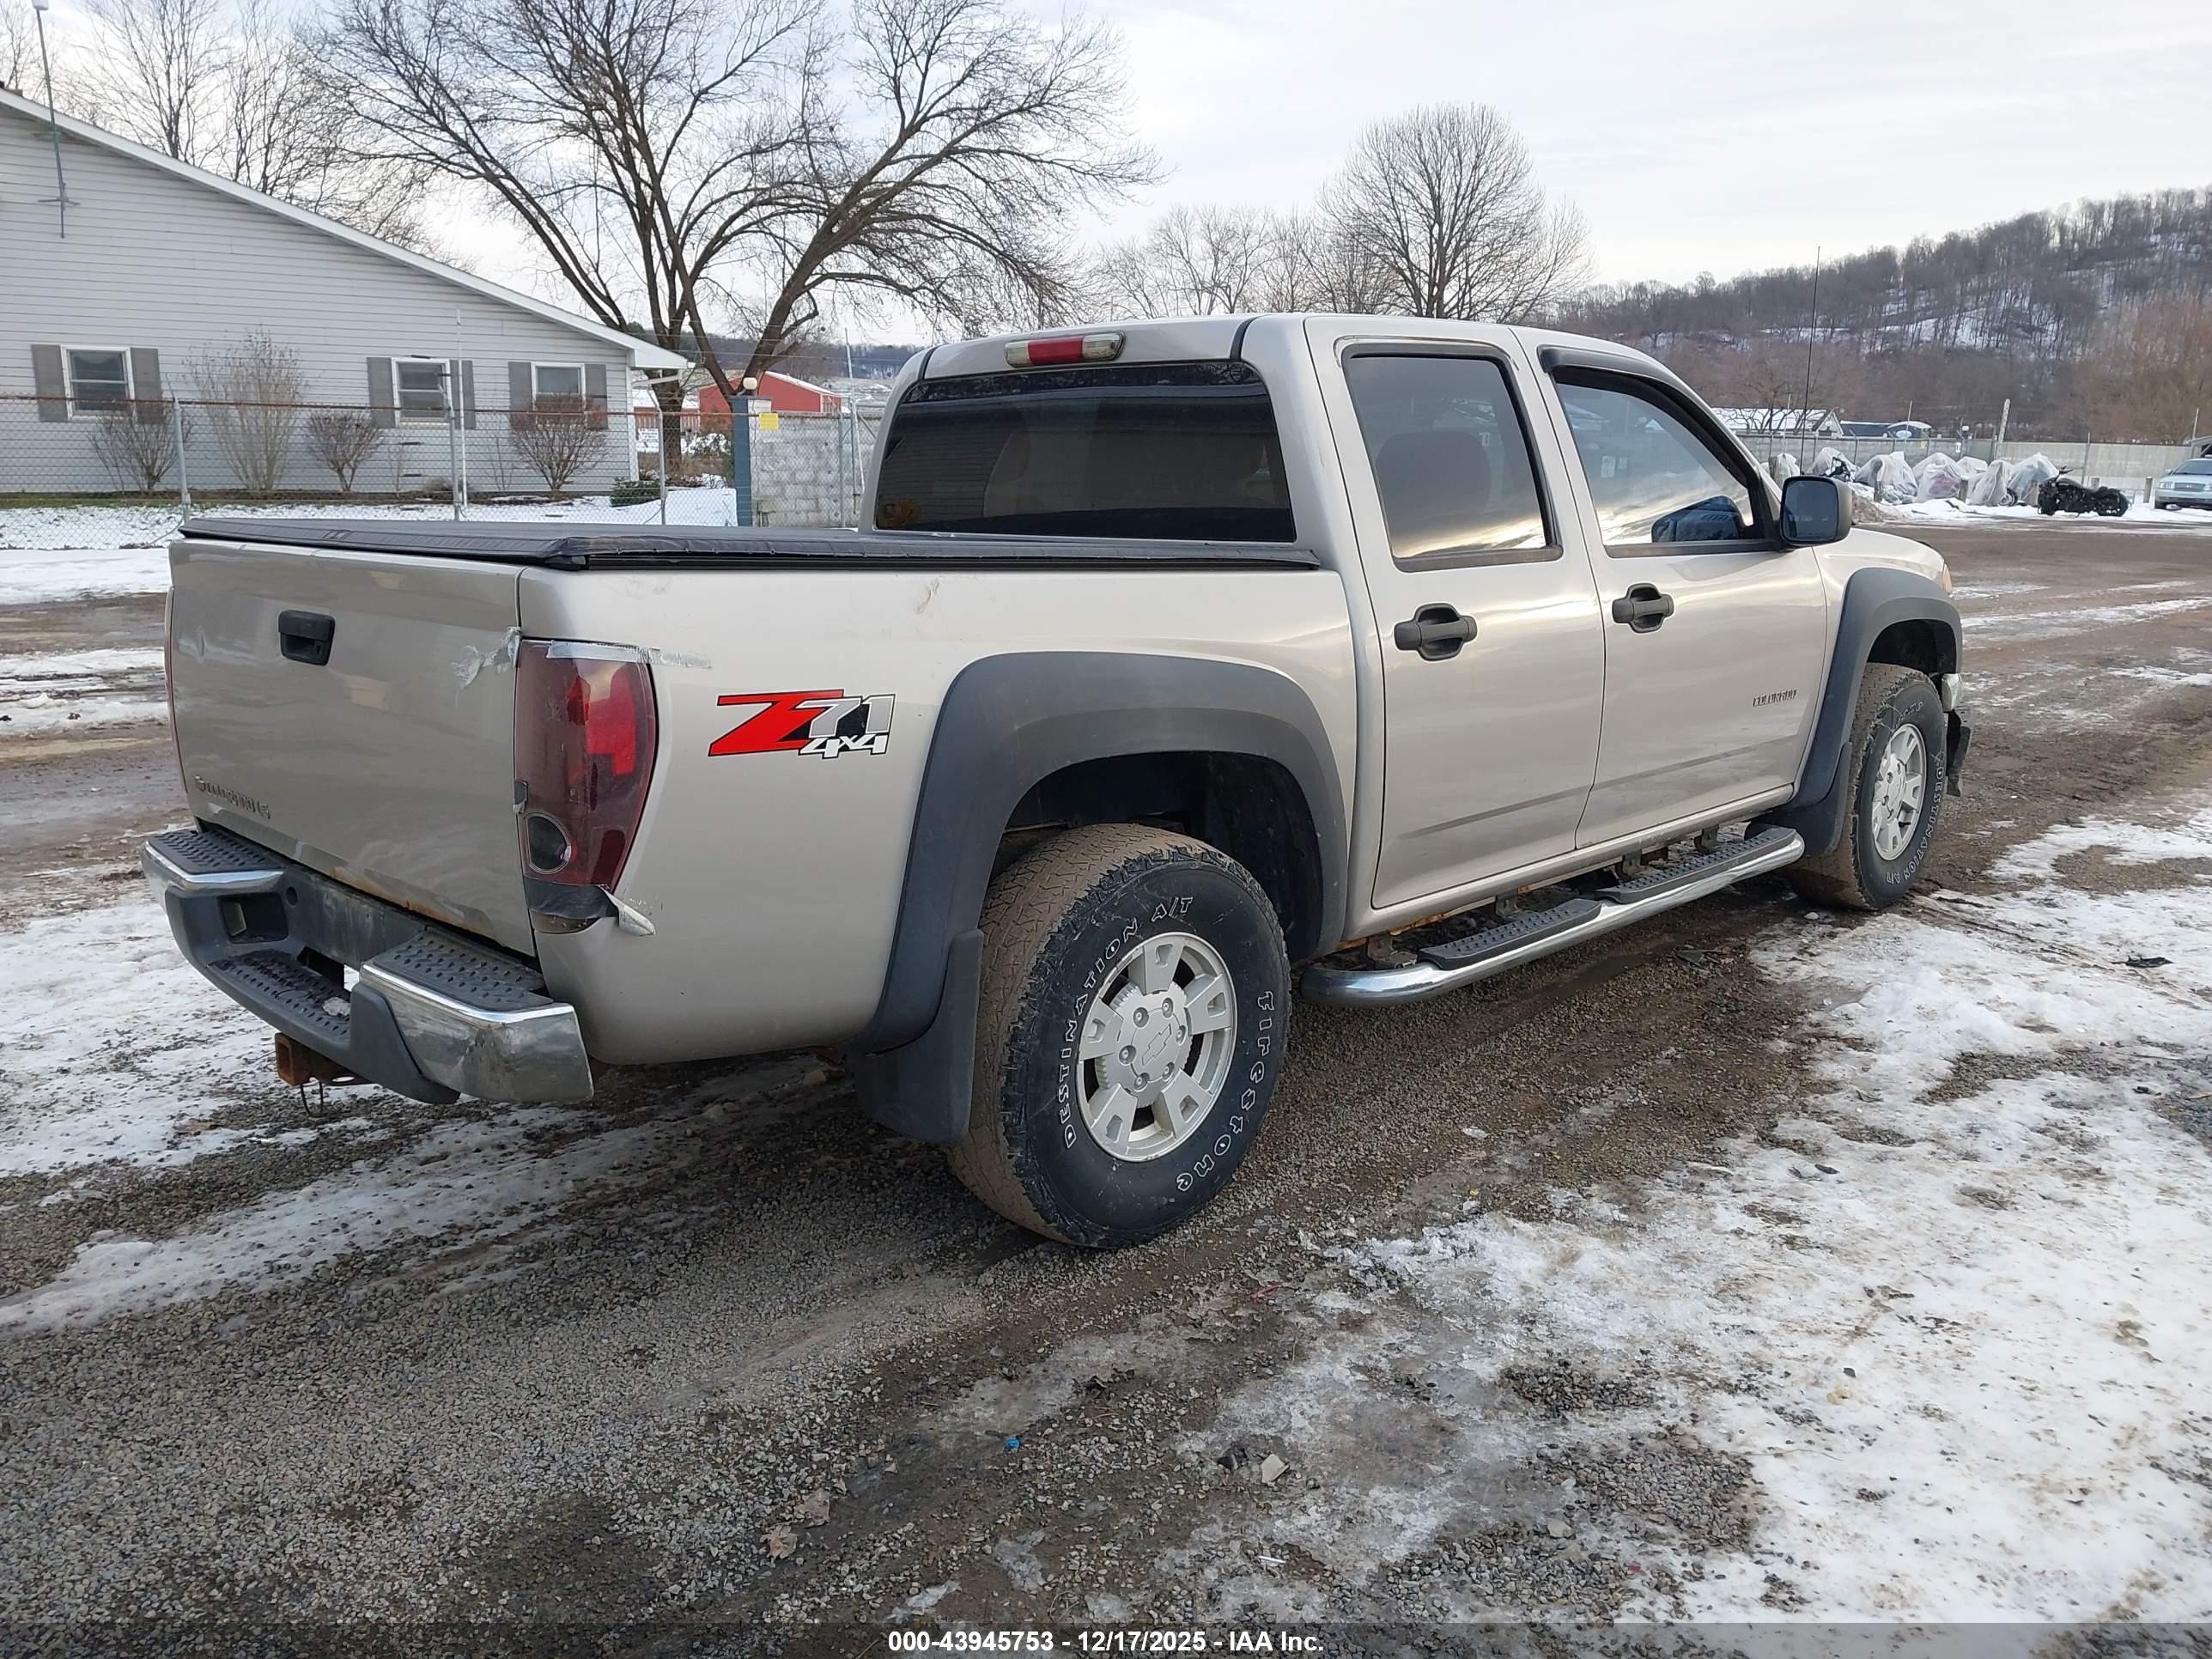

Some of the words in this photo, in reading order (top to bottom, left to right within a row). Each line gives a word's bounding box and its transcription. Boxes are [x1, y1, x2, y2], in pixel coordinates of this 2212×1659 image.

[708, 689, 896, 757] Z71
[1058, 918, 1139, 1149] DESTINATION
[1152, 897, 1194, 921] A/T
[1176, 991, 1274, 1192] Firestone
